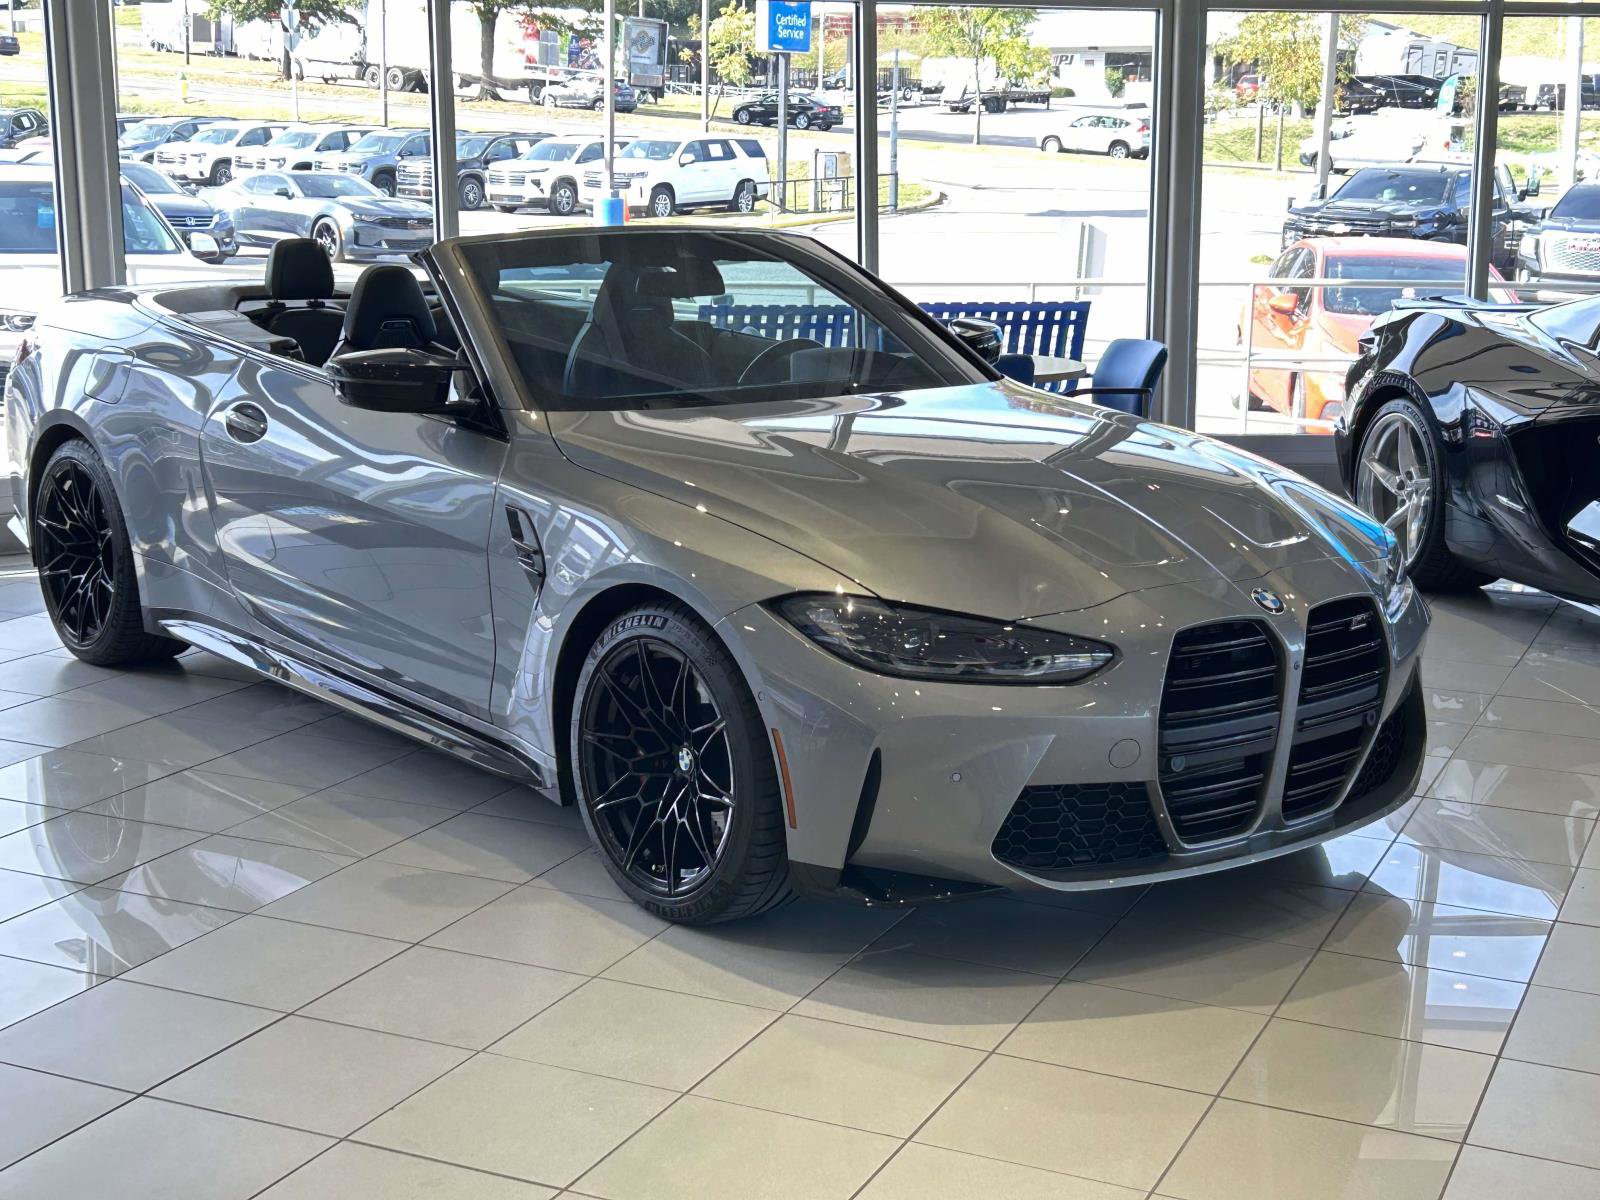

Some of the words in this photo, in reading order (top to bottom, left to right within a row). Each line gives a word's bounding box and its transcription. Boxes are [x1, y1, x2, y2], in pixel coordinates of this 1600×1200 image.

[775, 13, 807, 27] Certified
[778, 25, 805, 39] Service
[603, 615, 665, 642] MICHELIN
